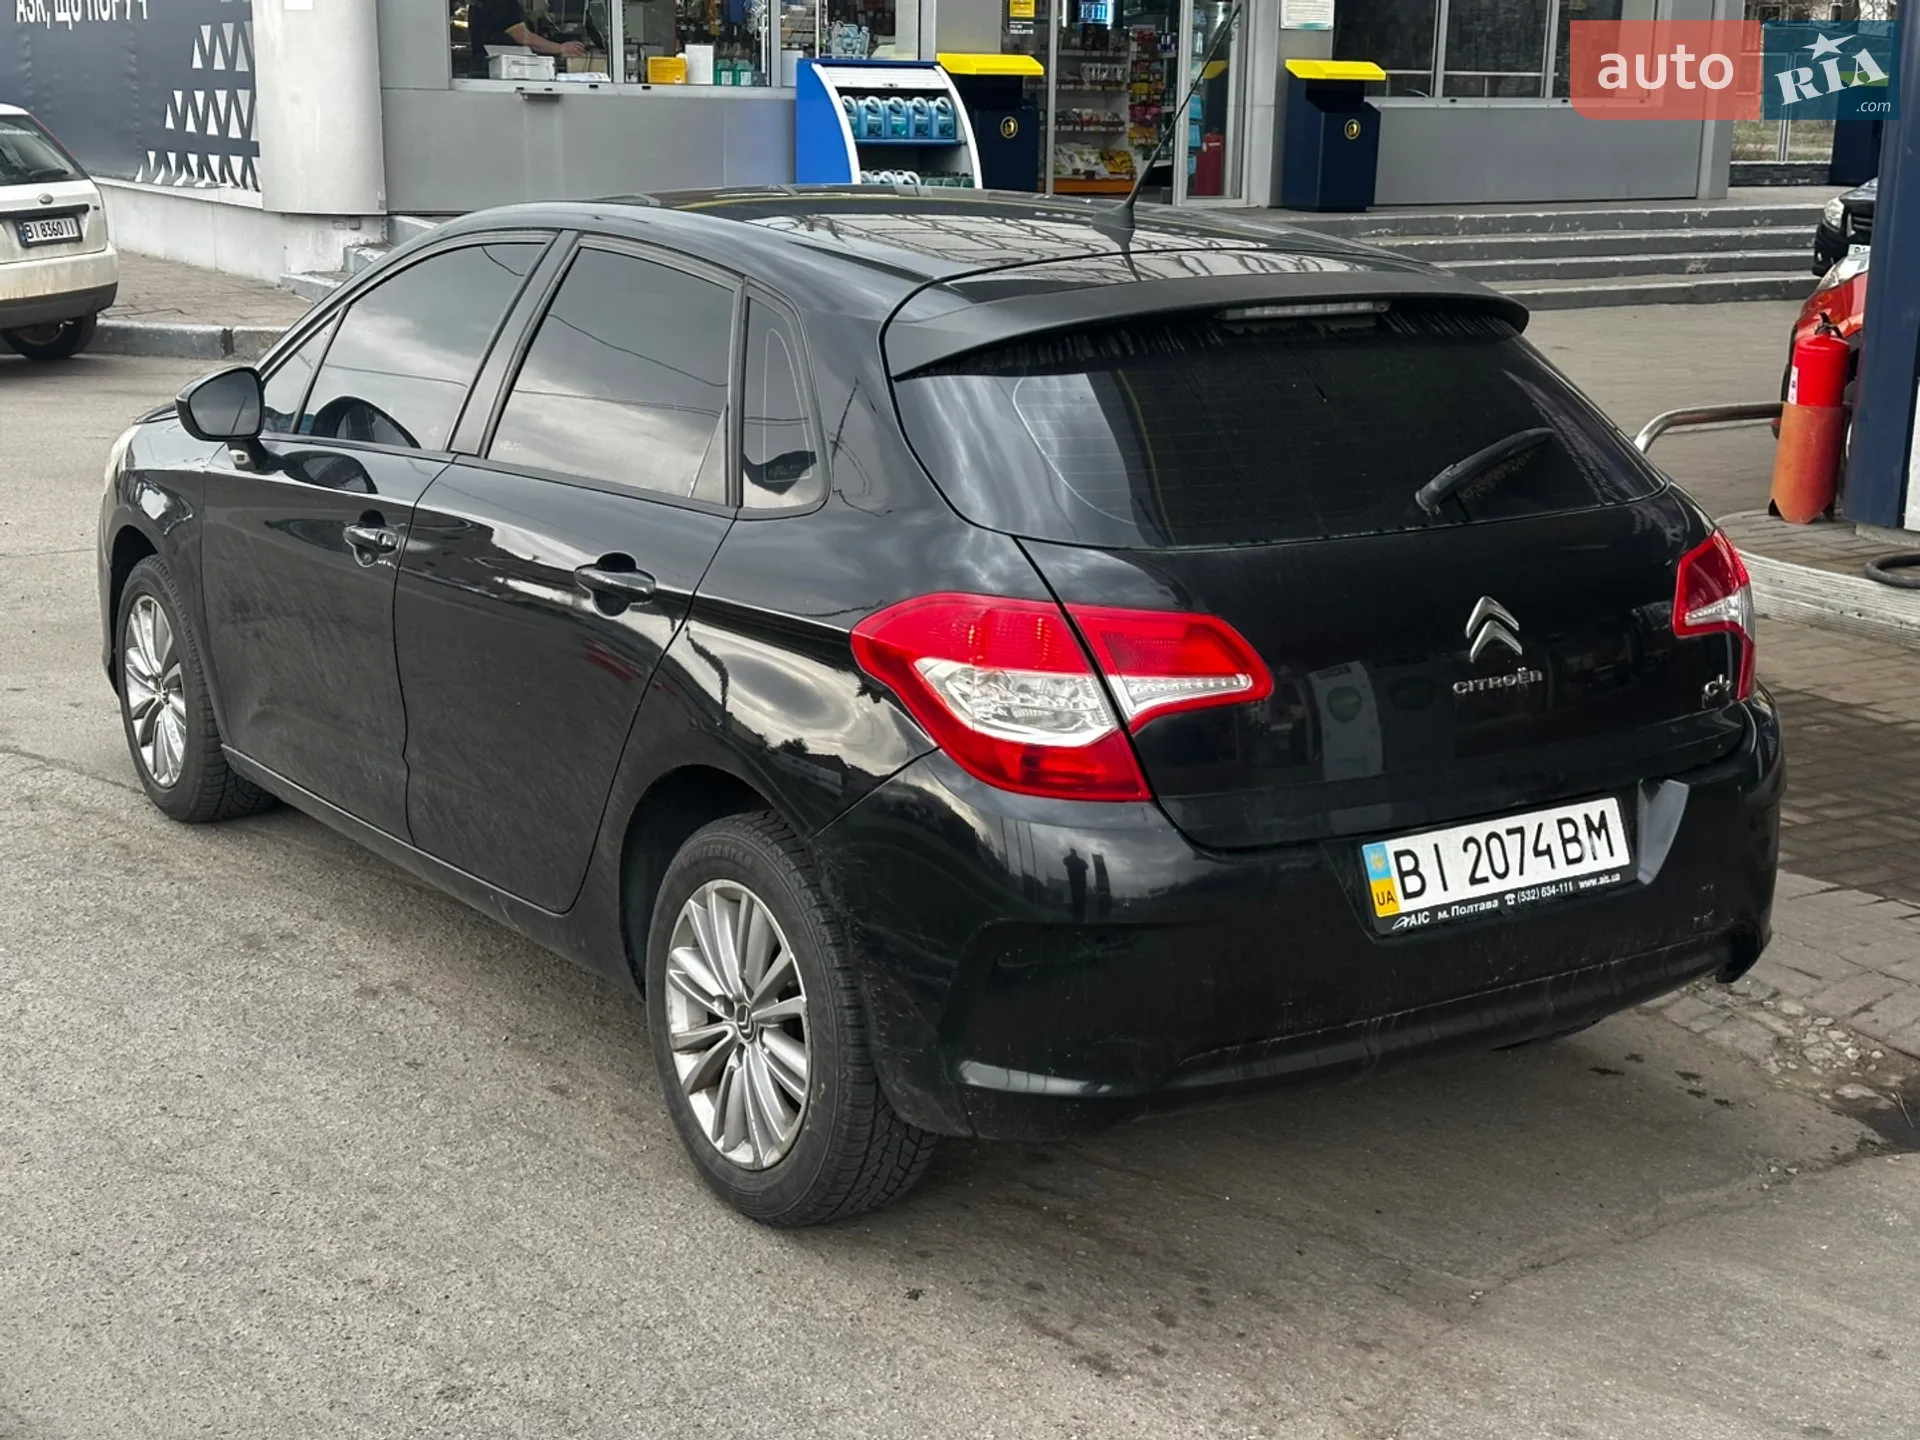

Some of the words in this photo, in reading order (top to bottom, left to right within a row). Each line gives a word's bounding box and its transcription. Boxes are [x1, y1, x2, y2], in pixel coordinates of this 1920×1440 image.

[1704, 674, 1732, 697] C4
[1376, 889, 1397, 907] UA
[1451, 899, 1499, 917] Полтава
[1517, 886, 1540, 904] (532)
[1541, 880, 1573, 898] 634-111
[1579, 872, 1621, 889] www.ais.ua
